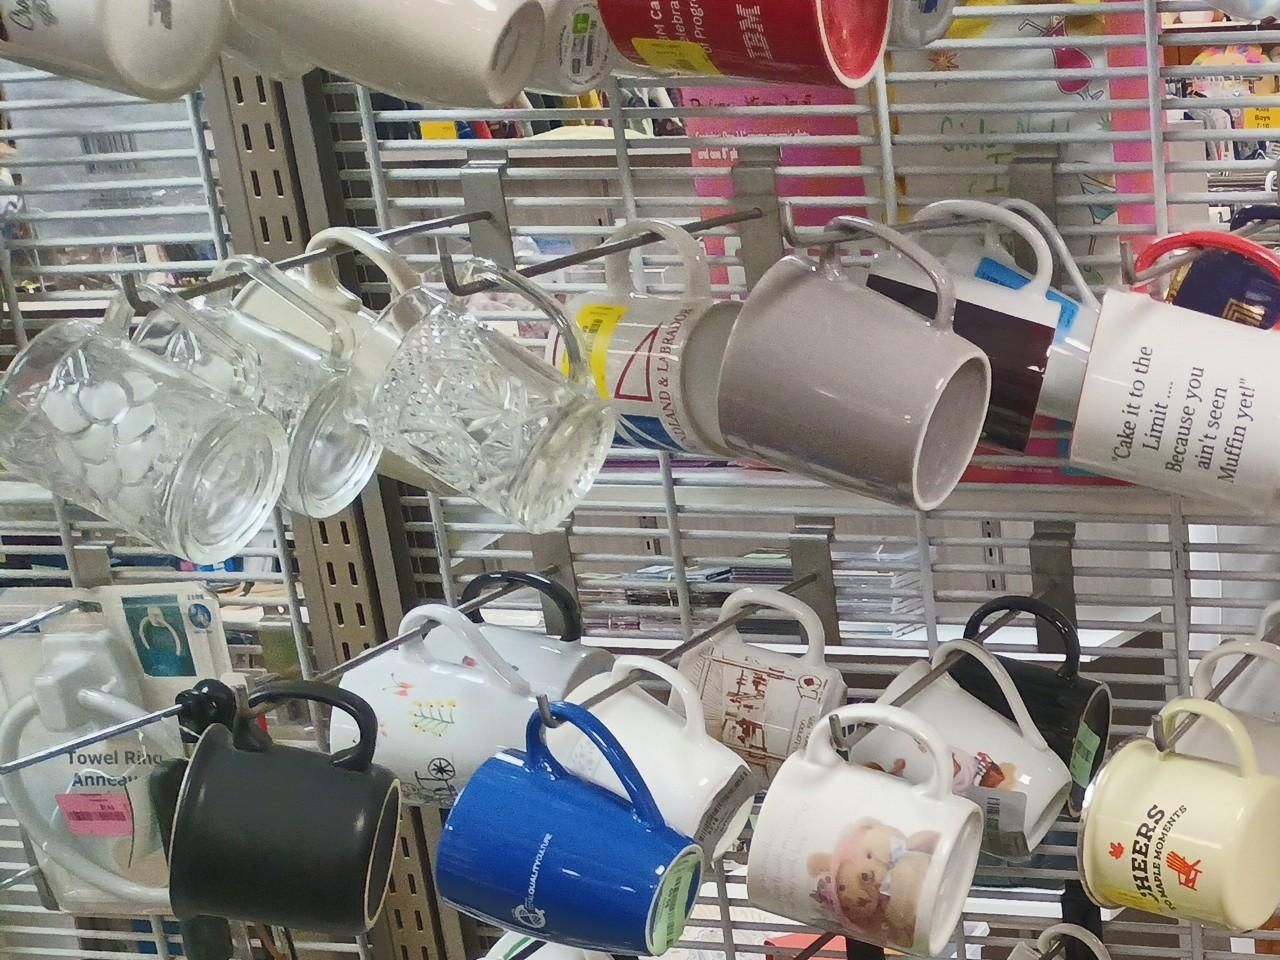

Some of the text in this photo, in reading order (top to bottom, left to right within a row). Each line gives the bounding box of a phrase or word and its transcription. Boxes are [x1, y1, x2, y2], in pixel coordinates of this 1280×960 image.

[736, 3, 774, 62] IBM
[657, 307, 693, 373] LABRADOR
[1132, 346, 1153, 376] the
[657, 377, 669, 388] &
[1129, 378, 1146, 400] to
[1121, 403, 1141, 418] it
[1142, 402, 1169, 452] Limit
[1165, 366, 1205, 473] Because you
[1195, 386, 1228, 471] ain't seen
[1217, 426, 1248, 485] Muffin
[66, 750, 119, 765] Towel
[1153, 805, 1188, 861] MOMENTS
[1153, 861, 1168, 899] MAPLE
